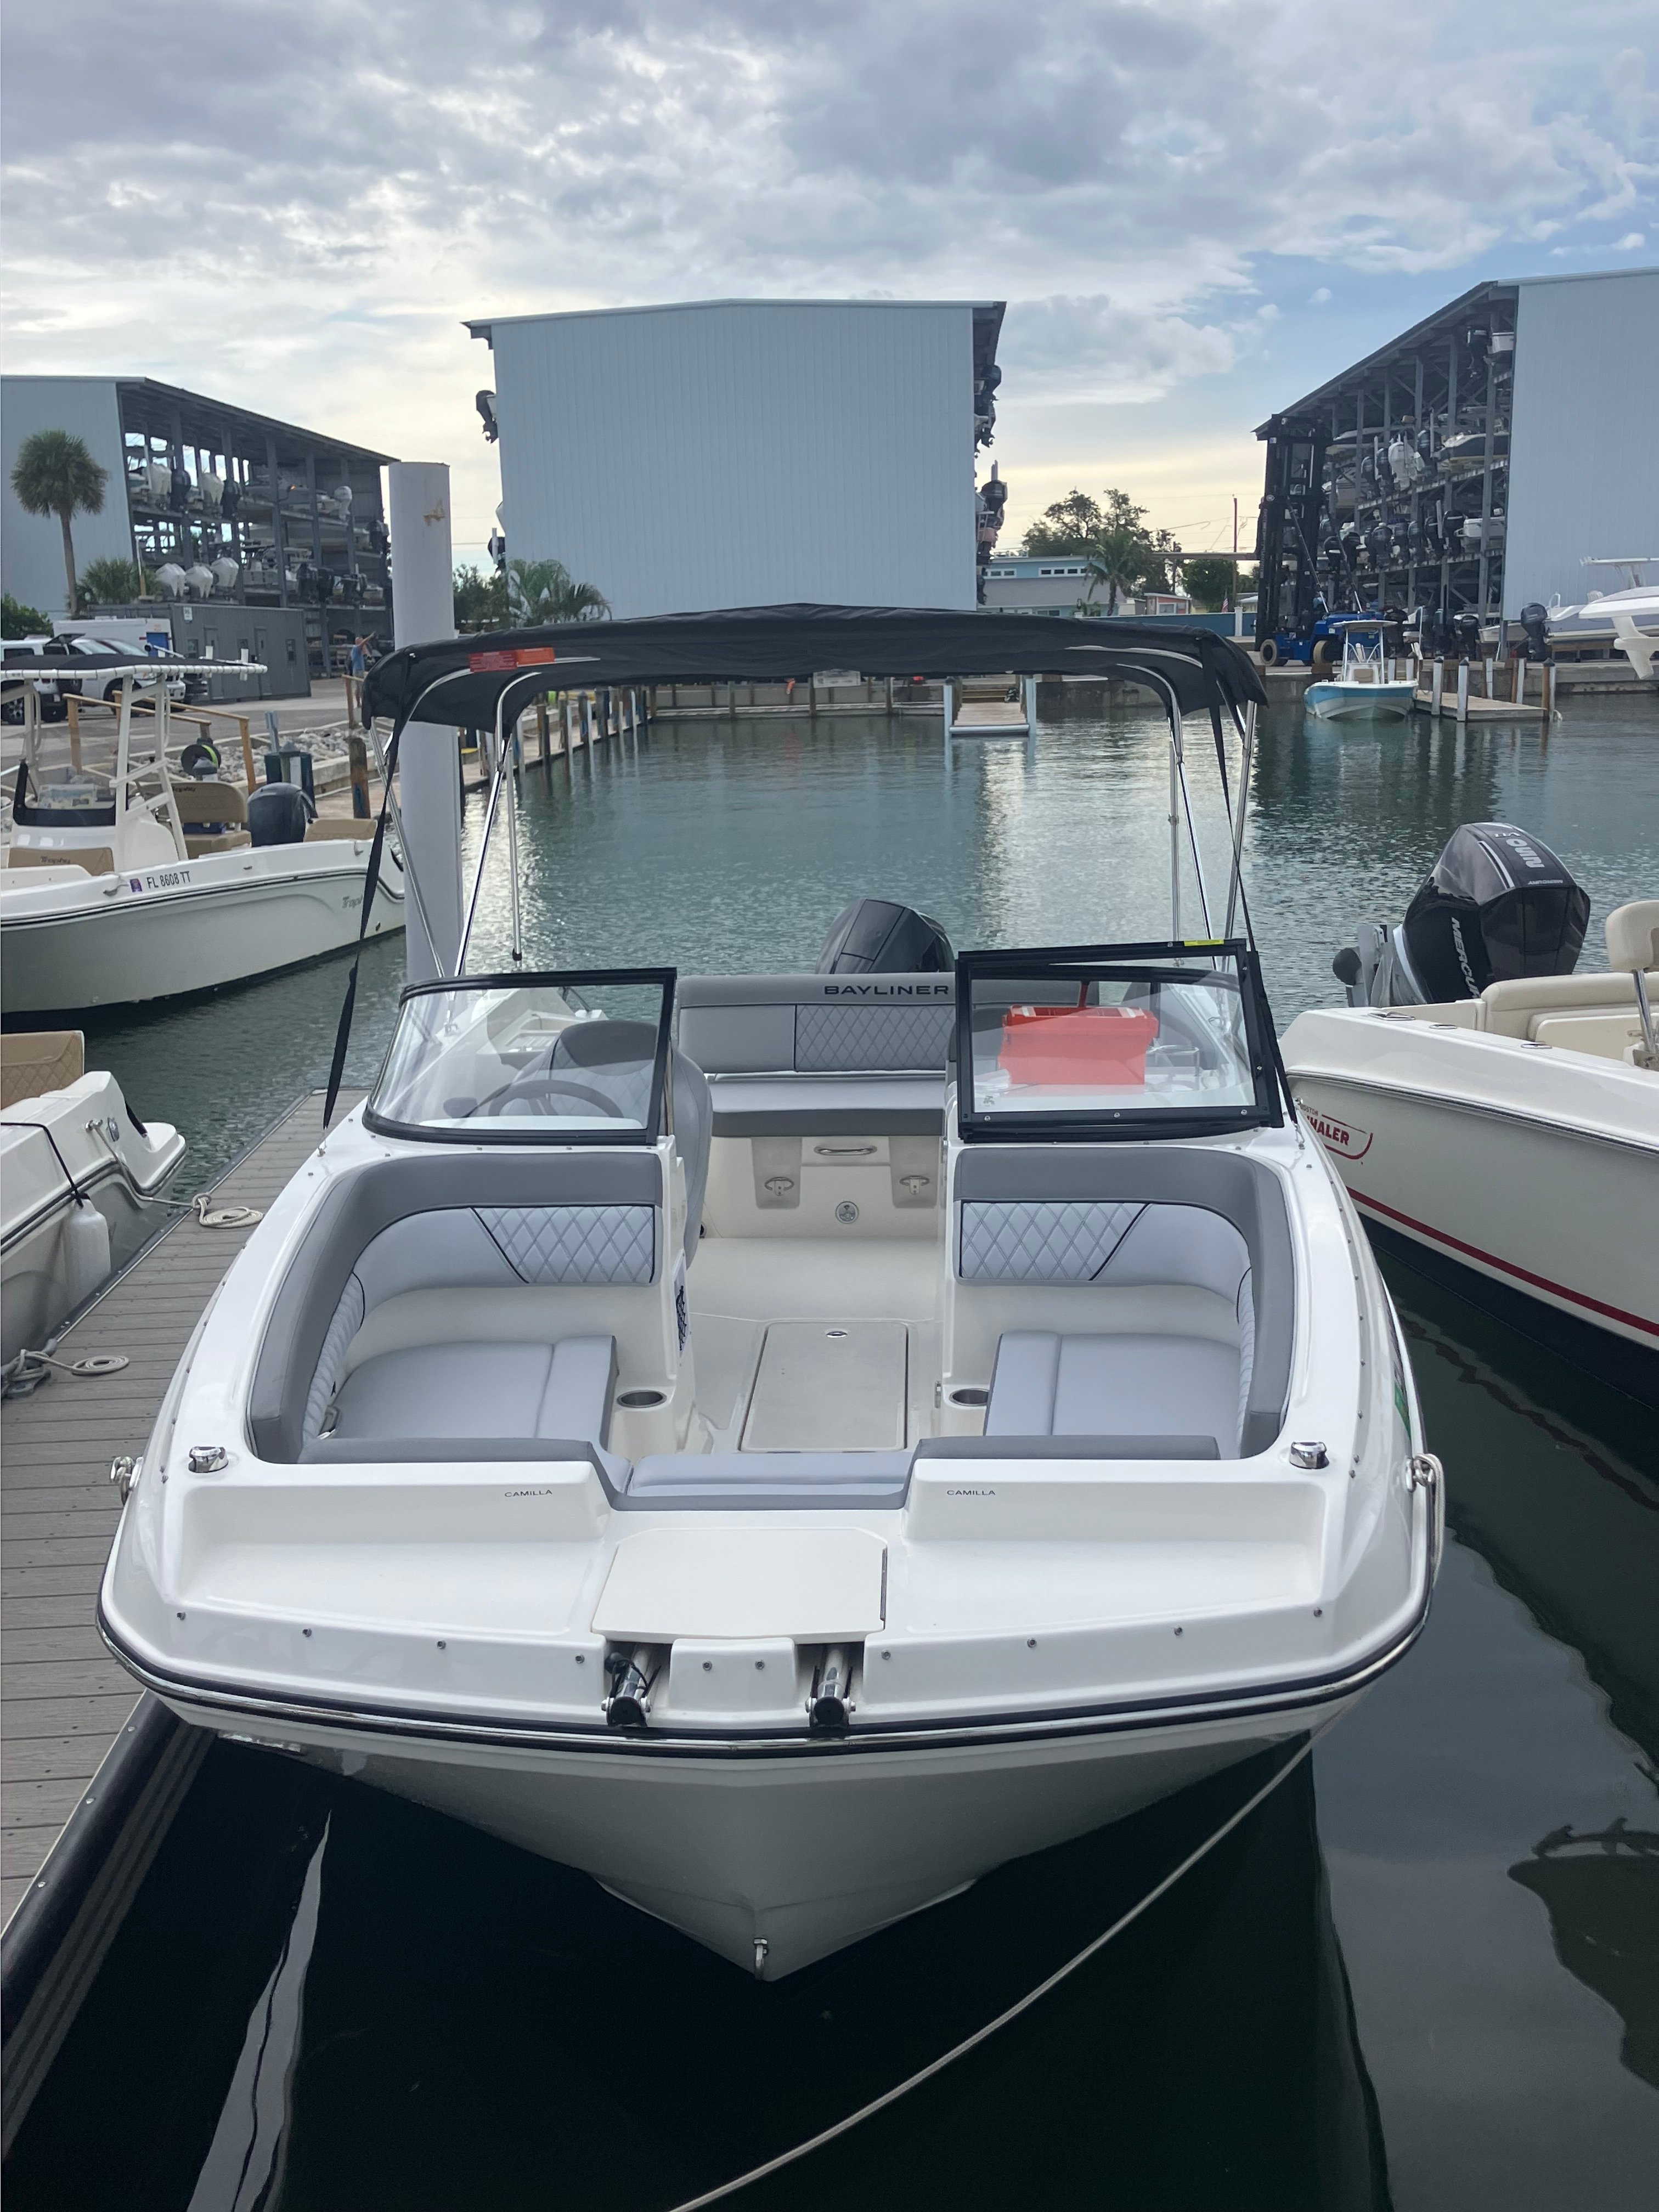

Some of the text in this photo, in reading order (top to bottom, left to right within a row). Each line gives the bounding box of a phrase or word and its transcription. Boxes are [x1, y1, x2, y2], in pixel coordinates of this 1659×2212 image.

[146, 871, 190, 889] FL 8608 TT
[824, 985, 949, 995] BAYLINER
[1306, 1115, 1350, 1146] HALER
[504, 1489, 552, 1498] CAMILLA
